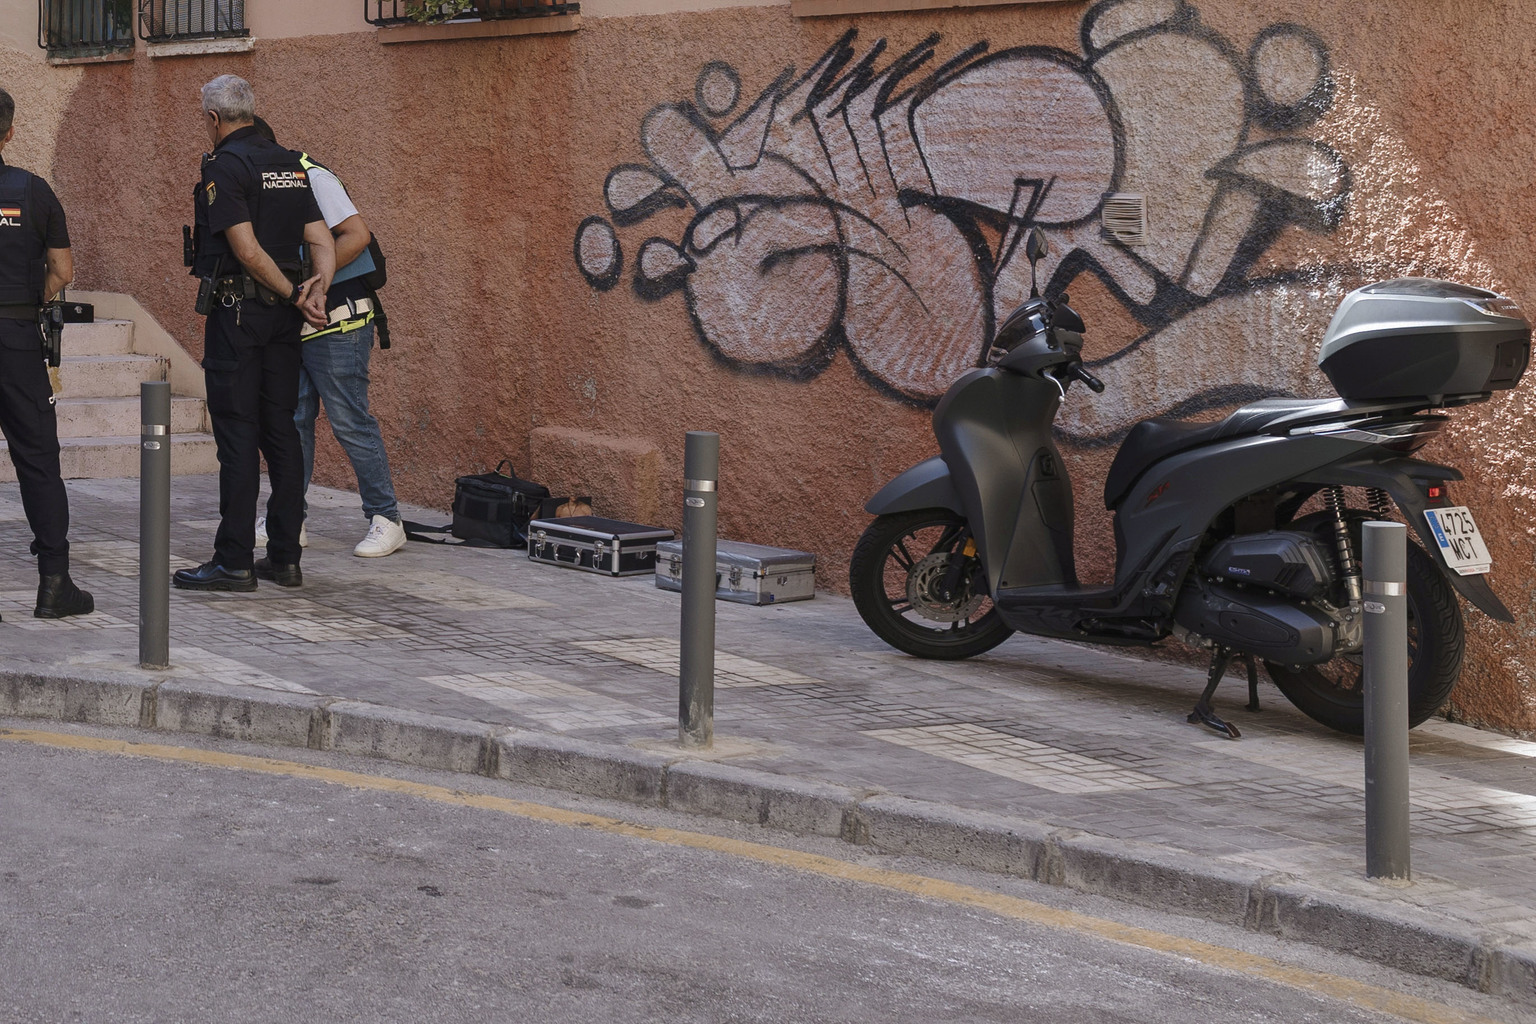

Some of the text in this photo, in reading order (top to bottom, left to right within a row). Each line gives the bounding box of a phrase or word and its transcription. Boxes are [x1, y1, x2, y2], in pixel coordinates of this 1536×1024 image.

[262, 172, 298, 180] POLICIA
[263, 180, 307, 189] NACIONAL
[1440, 511, 1475, 536] 4725
[1449, 537, 1478, 561] MCT
